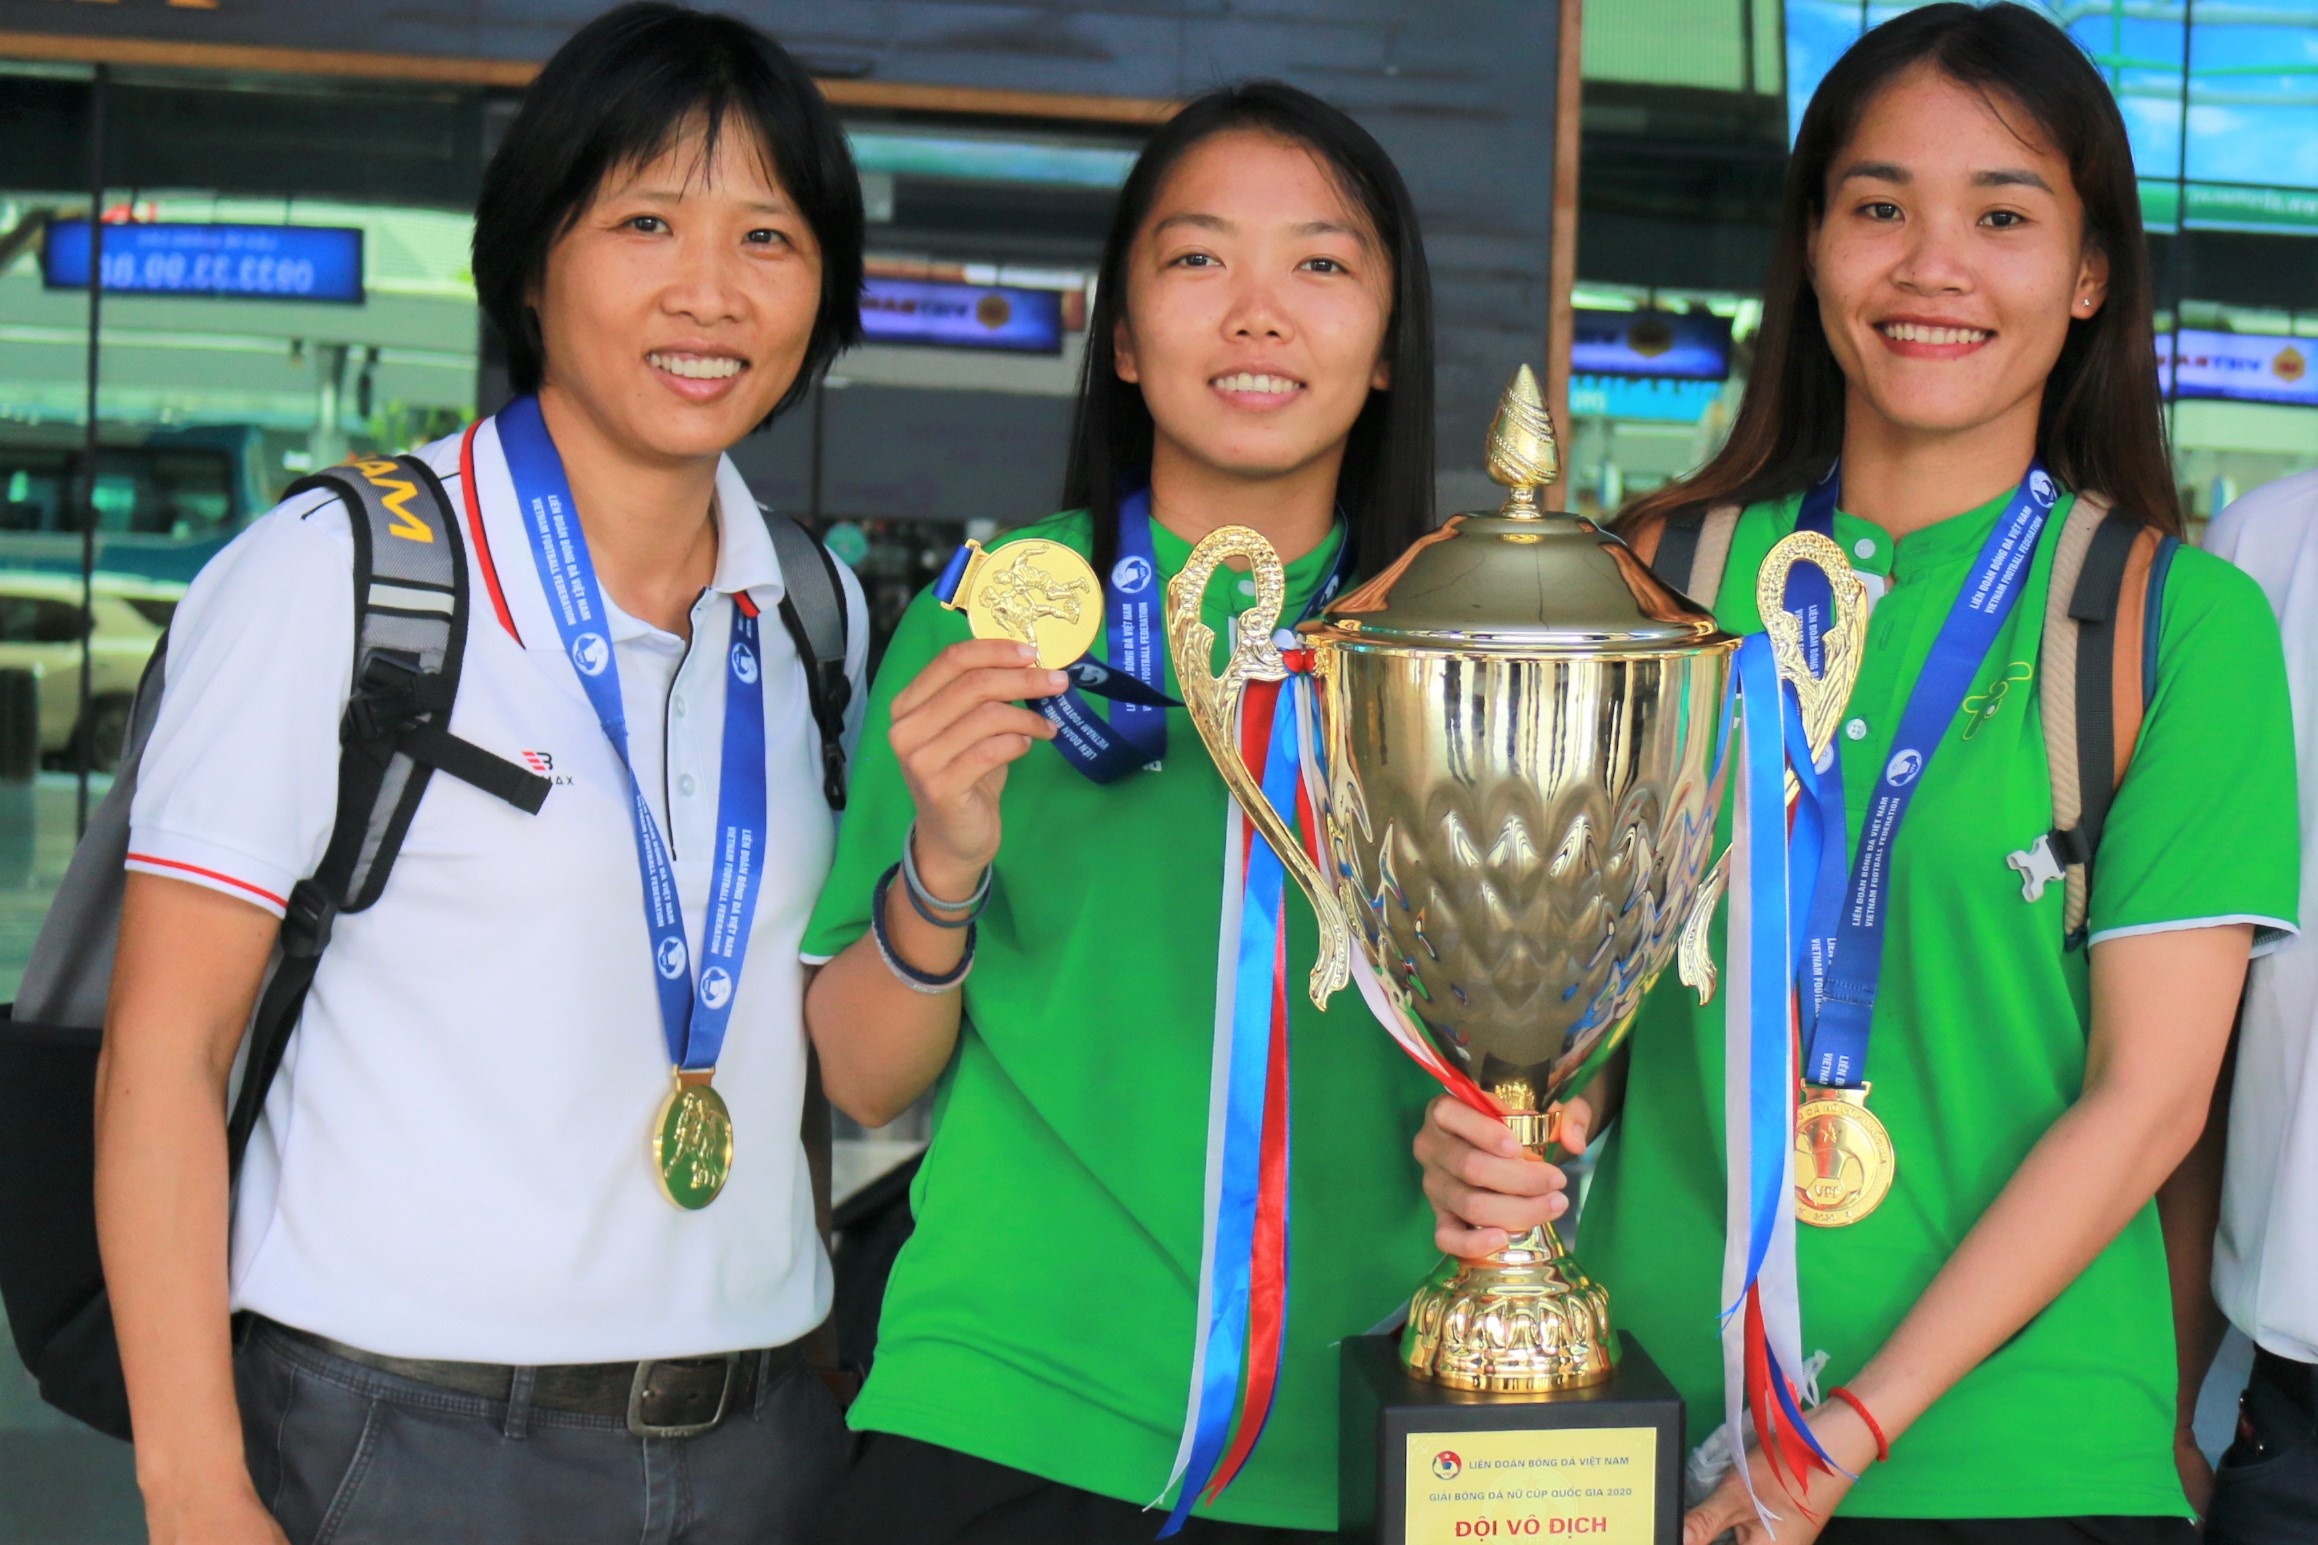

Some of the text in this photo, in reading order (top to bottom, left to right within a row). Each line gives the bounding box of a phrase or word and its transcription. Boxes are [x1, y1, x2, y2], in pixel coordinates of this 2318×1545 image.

[2016, 505, 2032, 525] NAM
[532, 497, 577, 626] VIETNAM FOOTBALL FEDERATION
[1984, 515, 2043, 614] VIETNAM FOOTBALL FEDERATION
[577, 598, 592, 621] NAM
[1122, 603, 1133, 620] NAM
[1138, 602, 1152, 682] FOOTBALL FEDERATION
[1080, 723, 1110, 750] VIETNAM
[1876, 796, 1889, 817] NAM
[1865, 797, 1900, 927] VIETNAM FOOTBALL FEDERATION
[643, 833, 656, 876] FOOTBALL
[650, 875, 665, 928] FEDERATION
[711, 826, 736, 955] VIETNAM FOOTBALL FEDERATION
[665, 901, 675, 925] NAM
[723, 933, 736, 958] NAM
[1811, 938, 1823, 976] VIETNAM
[1836, 1055, 1850, 1076] LIÊN
[1469, 1459, 1491, 1470] LIÊN
[1528, 1456, 1558, 1467] BÓNG
[1579, 1456, 1602, 1468] VIỆT
[1604, 1456, 1629, 1465] NAM
[1454, 1490, 1485, 1501] BÓNG
[1551, 1486, 1582, 1498] QUỐC
[1585, 1488, 1603, 1497] GIA
[1607, 1487, 1632, 1497] 2020
[1455, 1514, 1607, 1542] ĐỘI VÔ ĐỊCH
